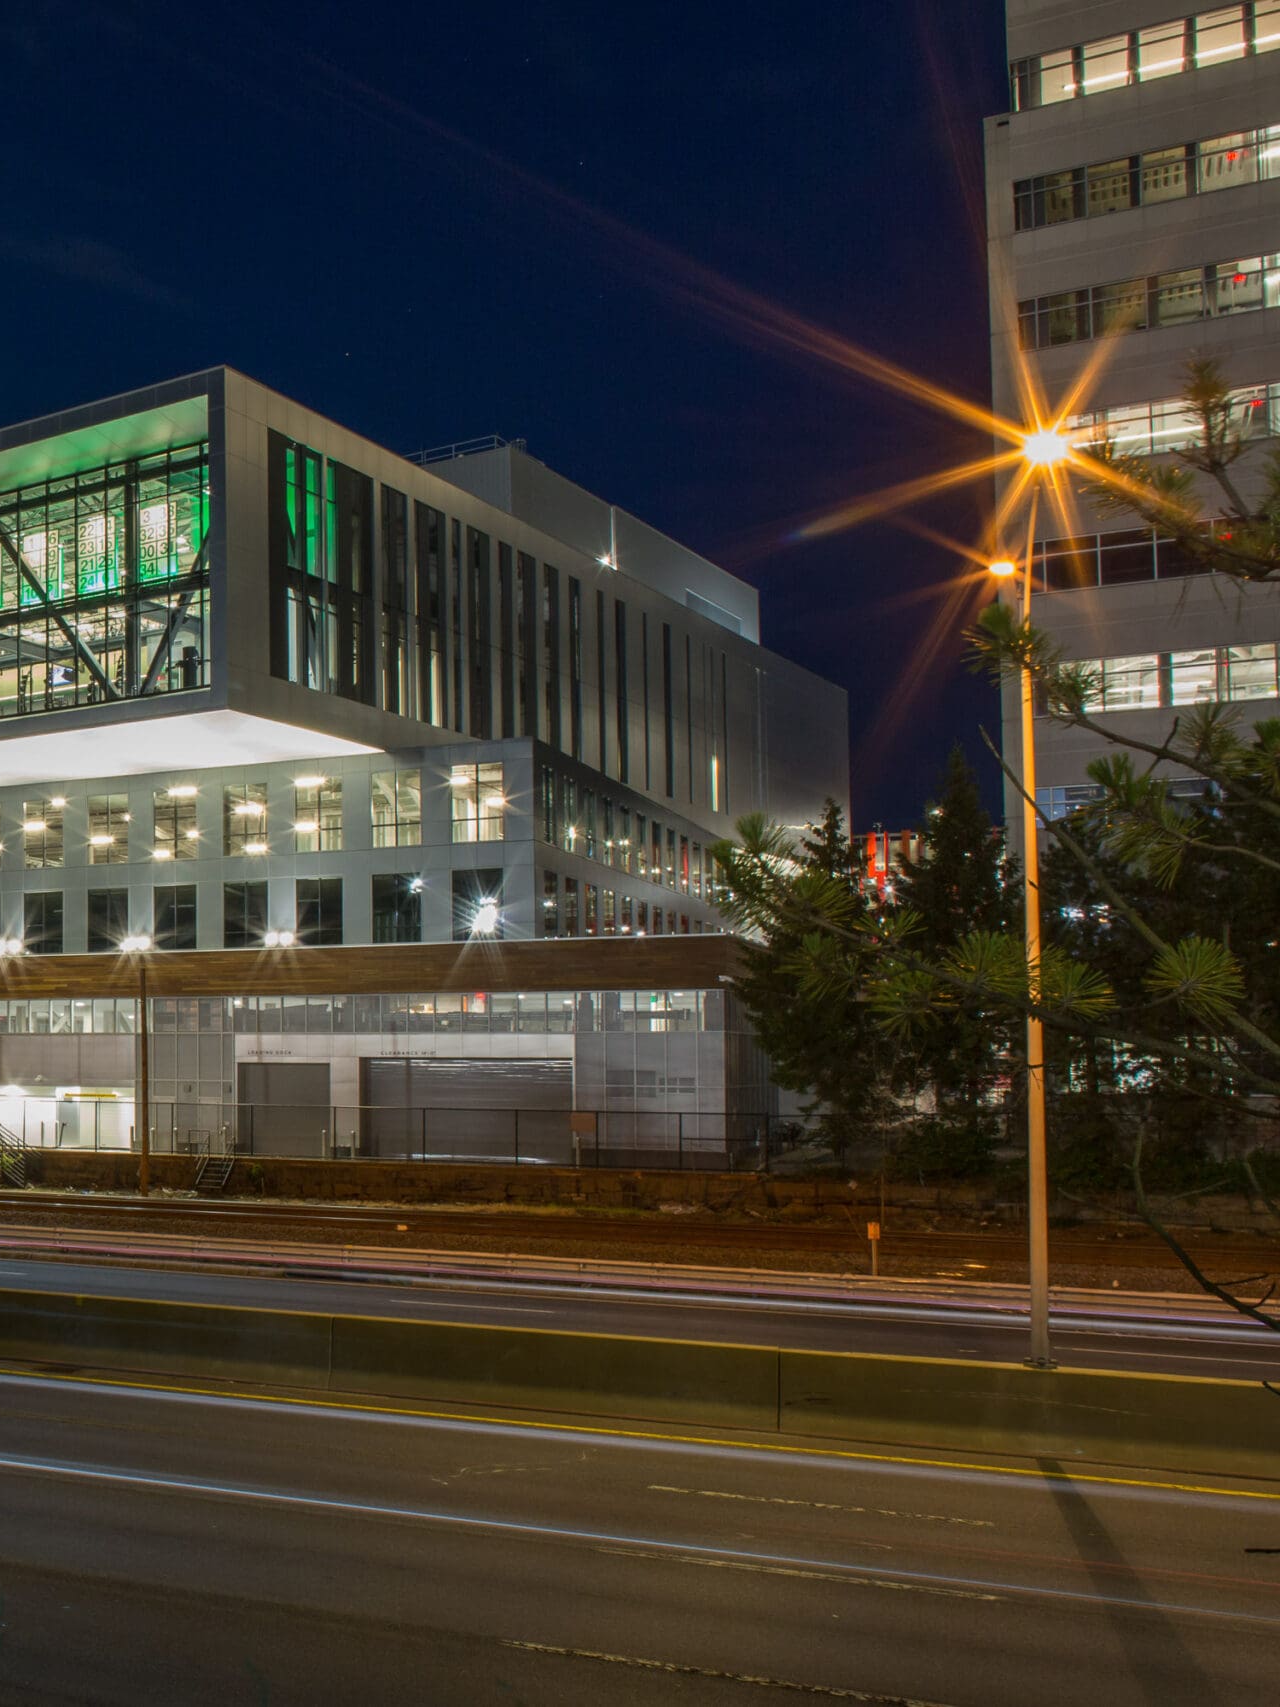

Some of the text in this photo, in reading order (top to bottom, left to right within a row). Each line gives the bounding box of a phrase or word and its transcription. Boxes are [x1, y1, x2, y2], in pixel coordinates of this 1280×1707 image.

[80, 524, 94, 538] 22
[80, 541, 95, 555] 23
[80, 558, 94, 572] 21
